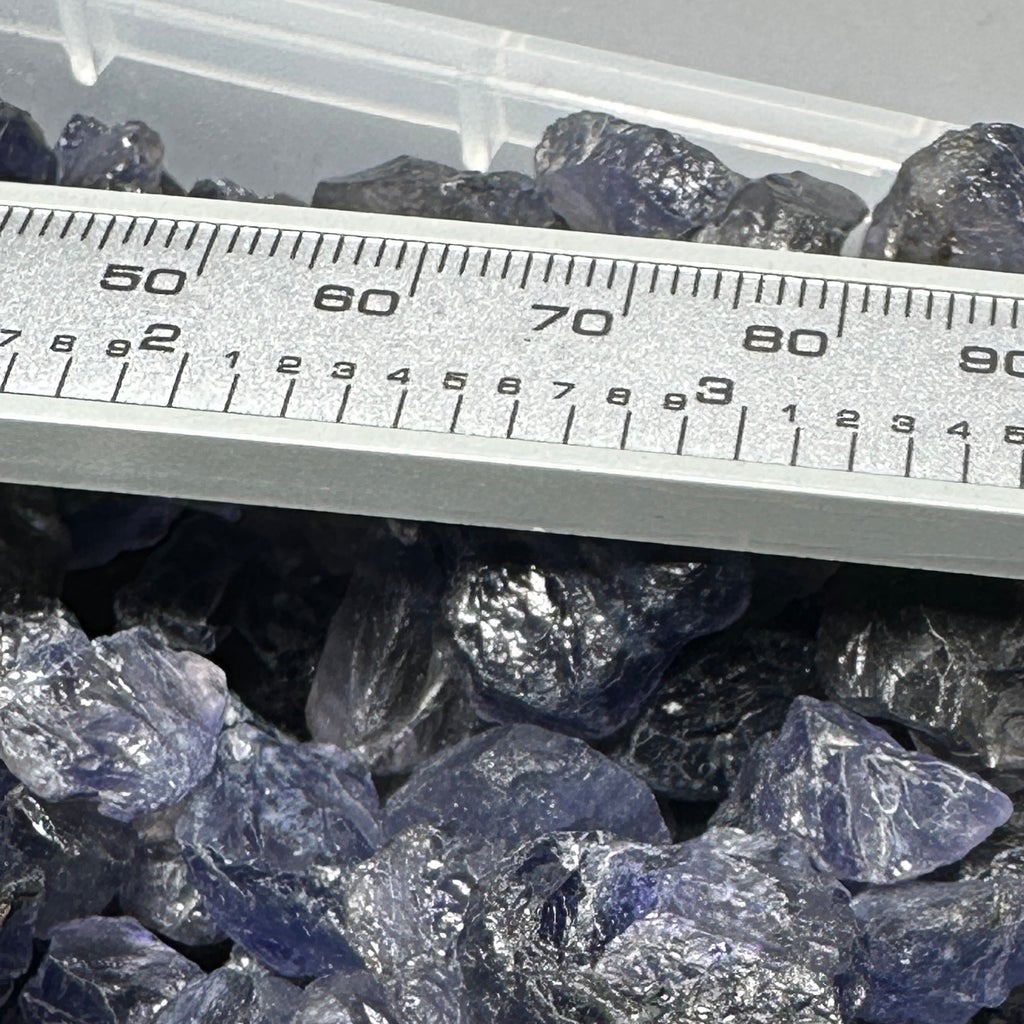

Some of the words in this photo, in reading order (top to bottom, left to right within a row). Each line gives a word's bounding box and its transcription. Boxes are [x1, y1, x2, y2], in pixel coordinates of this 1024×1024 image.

[100, 264, 188, 296] 50
[313, 283, 401, 318] 60
[530, 303, 614, 338] 70
[741, 324, 829, 359] 80
[50, 334, 78, 354] 8
[105, 339, 132, 359] 9
[138, 323, 182, 354] 2
[224, 350, 241, 370] 1
[275, 355, 303, 376] 2
[329, 360, 358, 381] 3
[385, 367, 411, 386] 4
[441, 370, 469, 392] 5
[496, 376, 522, 396] 6
[552, 380, 576, 400] 7
[605, 386, 632, 407] 8
[661, 392, 688, 413] 9
[694, 375, 735, 407] 3
[781, 403, 798, 424] 1
[835, 408, 861, 430] 2
[890, 413, 917, 435] 3
[946, 420, 972, 441] 4
